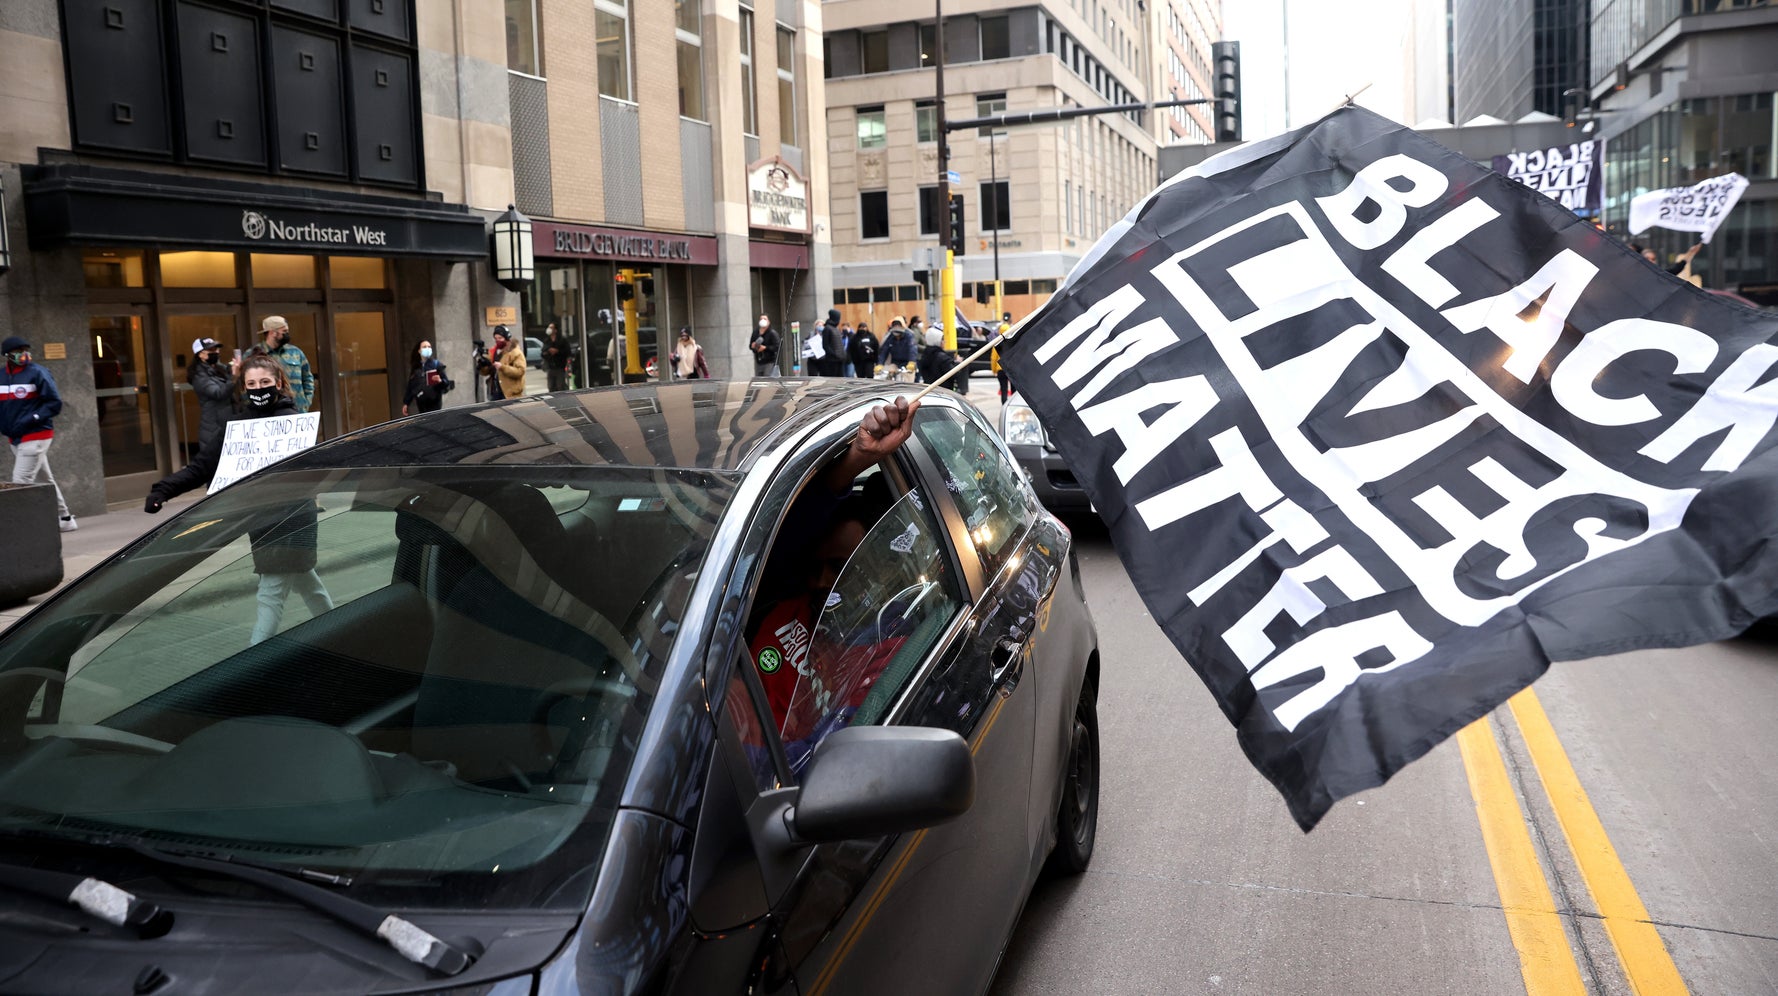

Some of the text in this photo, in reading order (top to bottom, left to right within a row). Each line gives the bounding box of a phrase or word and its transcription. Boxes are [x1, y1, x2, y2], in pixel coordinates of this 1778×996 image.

[268, 219, 386, 245] Northstar West
[553, 230, 692, 260] BRIDGEWATER BANK
[1314, 154, 1778, 473] BLACK
[1177, 212, 1650, 601] LIVES
[226, 416, 315, 440] IF WE STAND FOR
[267, 438, 284, 454] WE
[287, 436, 309, 452] FALL
[236, 456, 255, 471] FOR
[1032, 283, 1435, 733] MATTER
